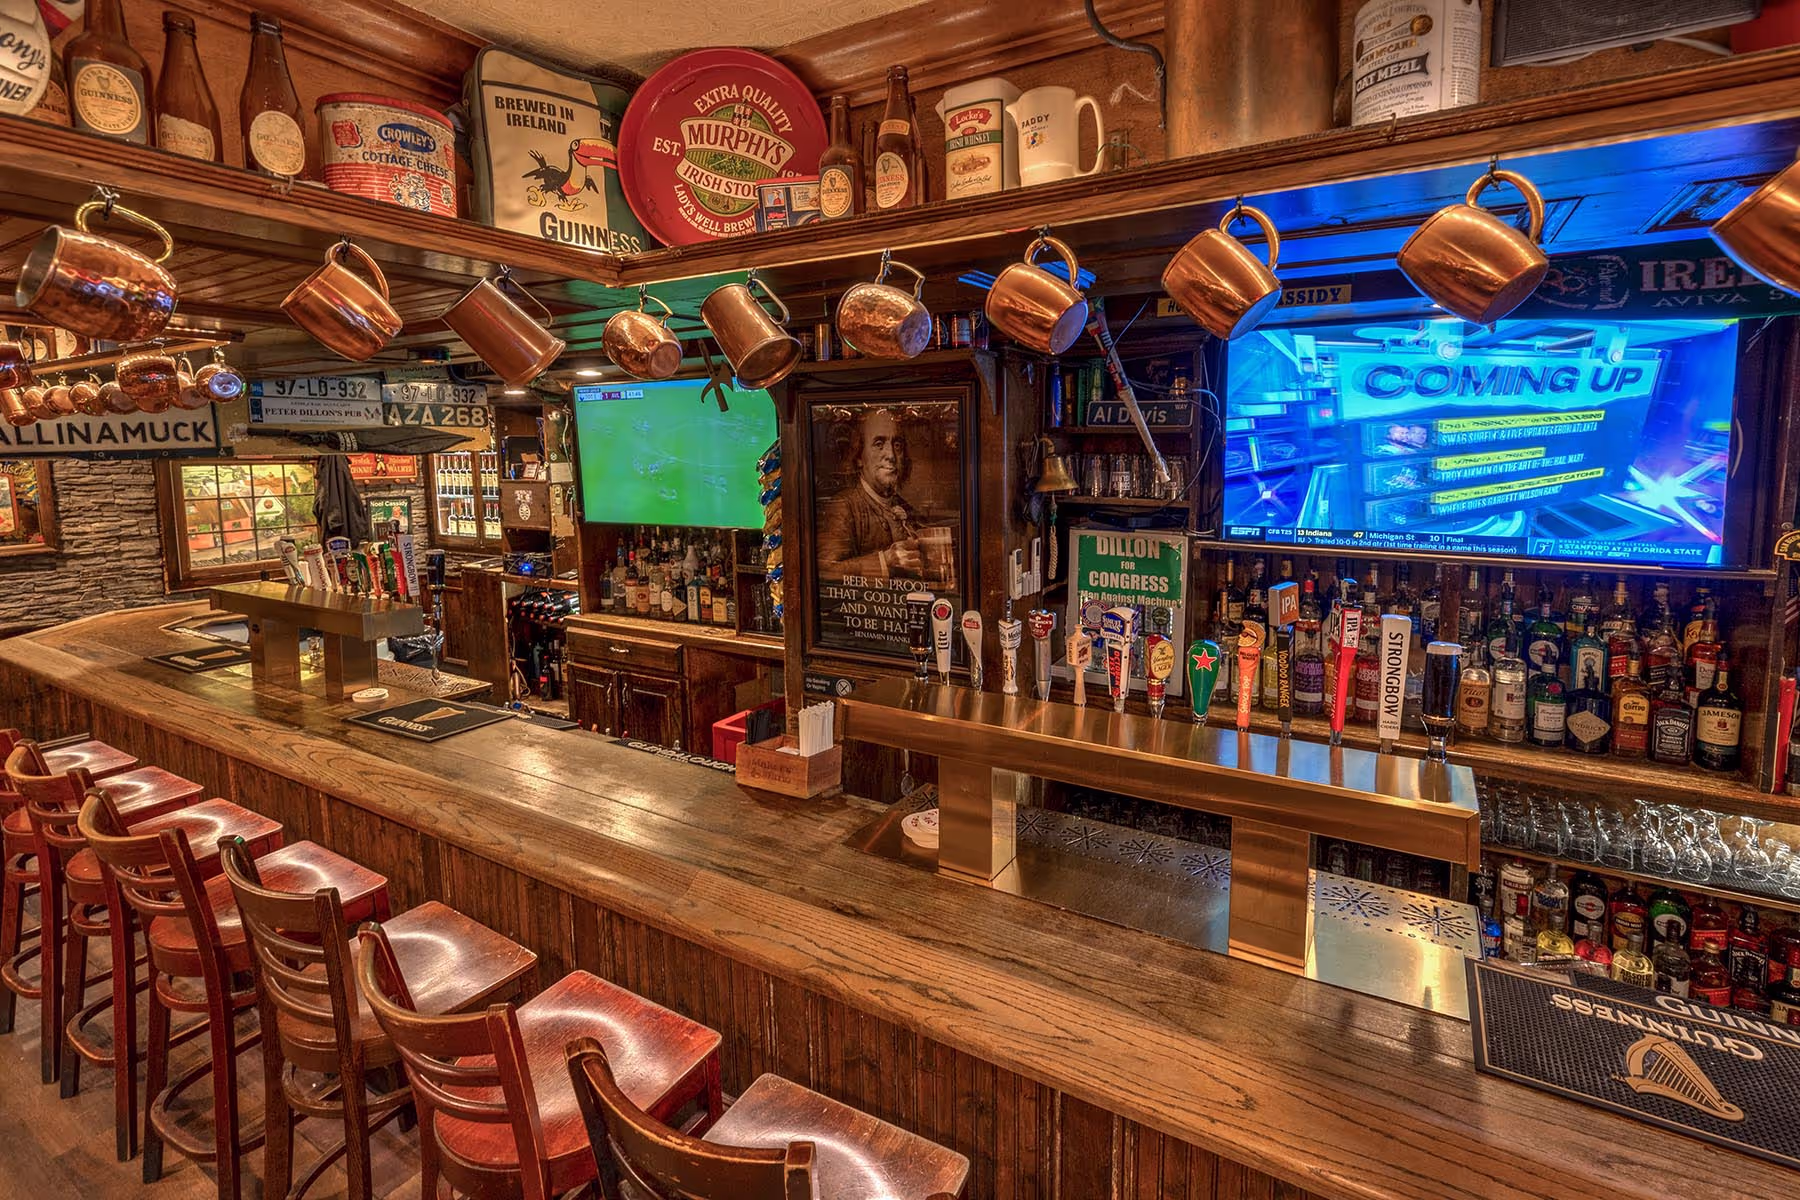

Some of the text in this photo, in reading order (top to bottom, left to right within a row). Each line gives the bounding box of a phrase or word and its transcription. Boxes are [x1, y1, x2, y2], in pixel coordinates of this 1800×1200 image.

[80, 88, 134, 105] GUINNESS
[494, 95, 575, 122] BREWED IN
[693, 84, 793, 133] EXTRA QUALITY
[955, 110, 984, 125] Locke's
[506, 112, 567, 135] IRELAND
[1021, 114, 1050, 129] PADDY
[381, 127, 435, 151] CROWLEY'S
[652, 137, 681, 156] EST.
[687, 124, 787, 166] MURPHY'S
[949, 132, 991, 150] IRISH WHISKEY
[361, 151, 449, 179] COTTAGE CHEESE
[683, 164, 723, 191] IRISH
[674, 183, 721, 232] LADY'S WELL
[539, 211, 642, 255] GUINNESS
[1652, 292, 1750, 308] AVIVA
[1365, 364, 1644, 400] COMING UP
[265, 408, 297, 416] PETER
[299, 408, 343, 417] DILLON'S
[388, 404, 486, 427] AZA 268
[1093, 406, 1113, 423] Al
[0, 419, 212, 446] ALLINAMUCK
[1524, 425, 1554, 439] UPDATES
[1554, 424, 1572, 436] FROM
[1572, 422, 1598, 434] ATLANTA
[1441, 470, 1462, 482] TROY
[1504, 463, 1518, 474] THE
[1518, 461, 1531, 471] ART
[1542, 456, 1554, 467] THE
[1564, 470, 1602, 481] CATCHES
[1439, 500, 1467, 515] WHERE
[1467, 497, 1488, 509] DOES
[1488, 492, 1518, 506] GARRETT
[1518, 489, 1543, 501] WILSON
[1230, 526, 1261, 536] ESPN
[1352, 531, 1364, 539] 47
[1369, 532, 1404, 542] Michigan
[1405, 533, 1415, 541] St
[1096, 535, 1161, 559] DILLON
[1315, 537, 1336, 545] Trailed
[1358, 539, 1372, 547] 2nd
[1372, 540, 1384, 549] qtr
[1384, 541, 1396, 549] (1st
[1413, 542, 1438, 551] trailing
[1438, 543, 1446, 551] in
[1452, 545, 1472, 553] game
[1487, 546, 1518, 554] season)
[1564, 543, 1610, 552] STANFORD
[1633, 547, 1672, 555] FLORIDA
[1673, 548, 1703, 556] STATE
[403, 542, 418, 584] STRONGBOW
[1120, 560, 1136, 571] FOR
[843, 575, 929, 593] BEER IS PROOF
[1088, 571, 1169, 593] CONGRESS
[826, 586, 891, 604] THAT GOD
[1101, 592, 1135, 604] Against
[839, 602, 868, 616] AND
[1281, 594, 1297, 615] IPA
[843, 615, 879, 631] TO BE
[1346, 616, 1358, 633] IPA
[854, 631, 886, 642] BENJAMIN
[937, 630, 950, 650] lite
[1154, 663, 1172, 673] LAGER
[1384, 632, 1404, 718] STRONGBOW
[1242, 676, 1251, 690] TOP
[1278, 650, 1290, 708] VOODOO RANGER
[1463, 687, 1487, 696] Tito's
[1623, 702, 1646, 711] Cuervo
[377, 716, 435, 732] GUINNESS
[1656, 719, 1689, 732] JACK DANIEL'S
[1553, 993, 1764, 1061] GUINNESS
[1655, 995, 1800, 1043] GUINN
